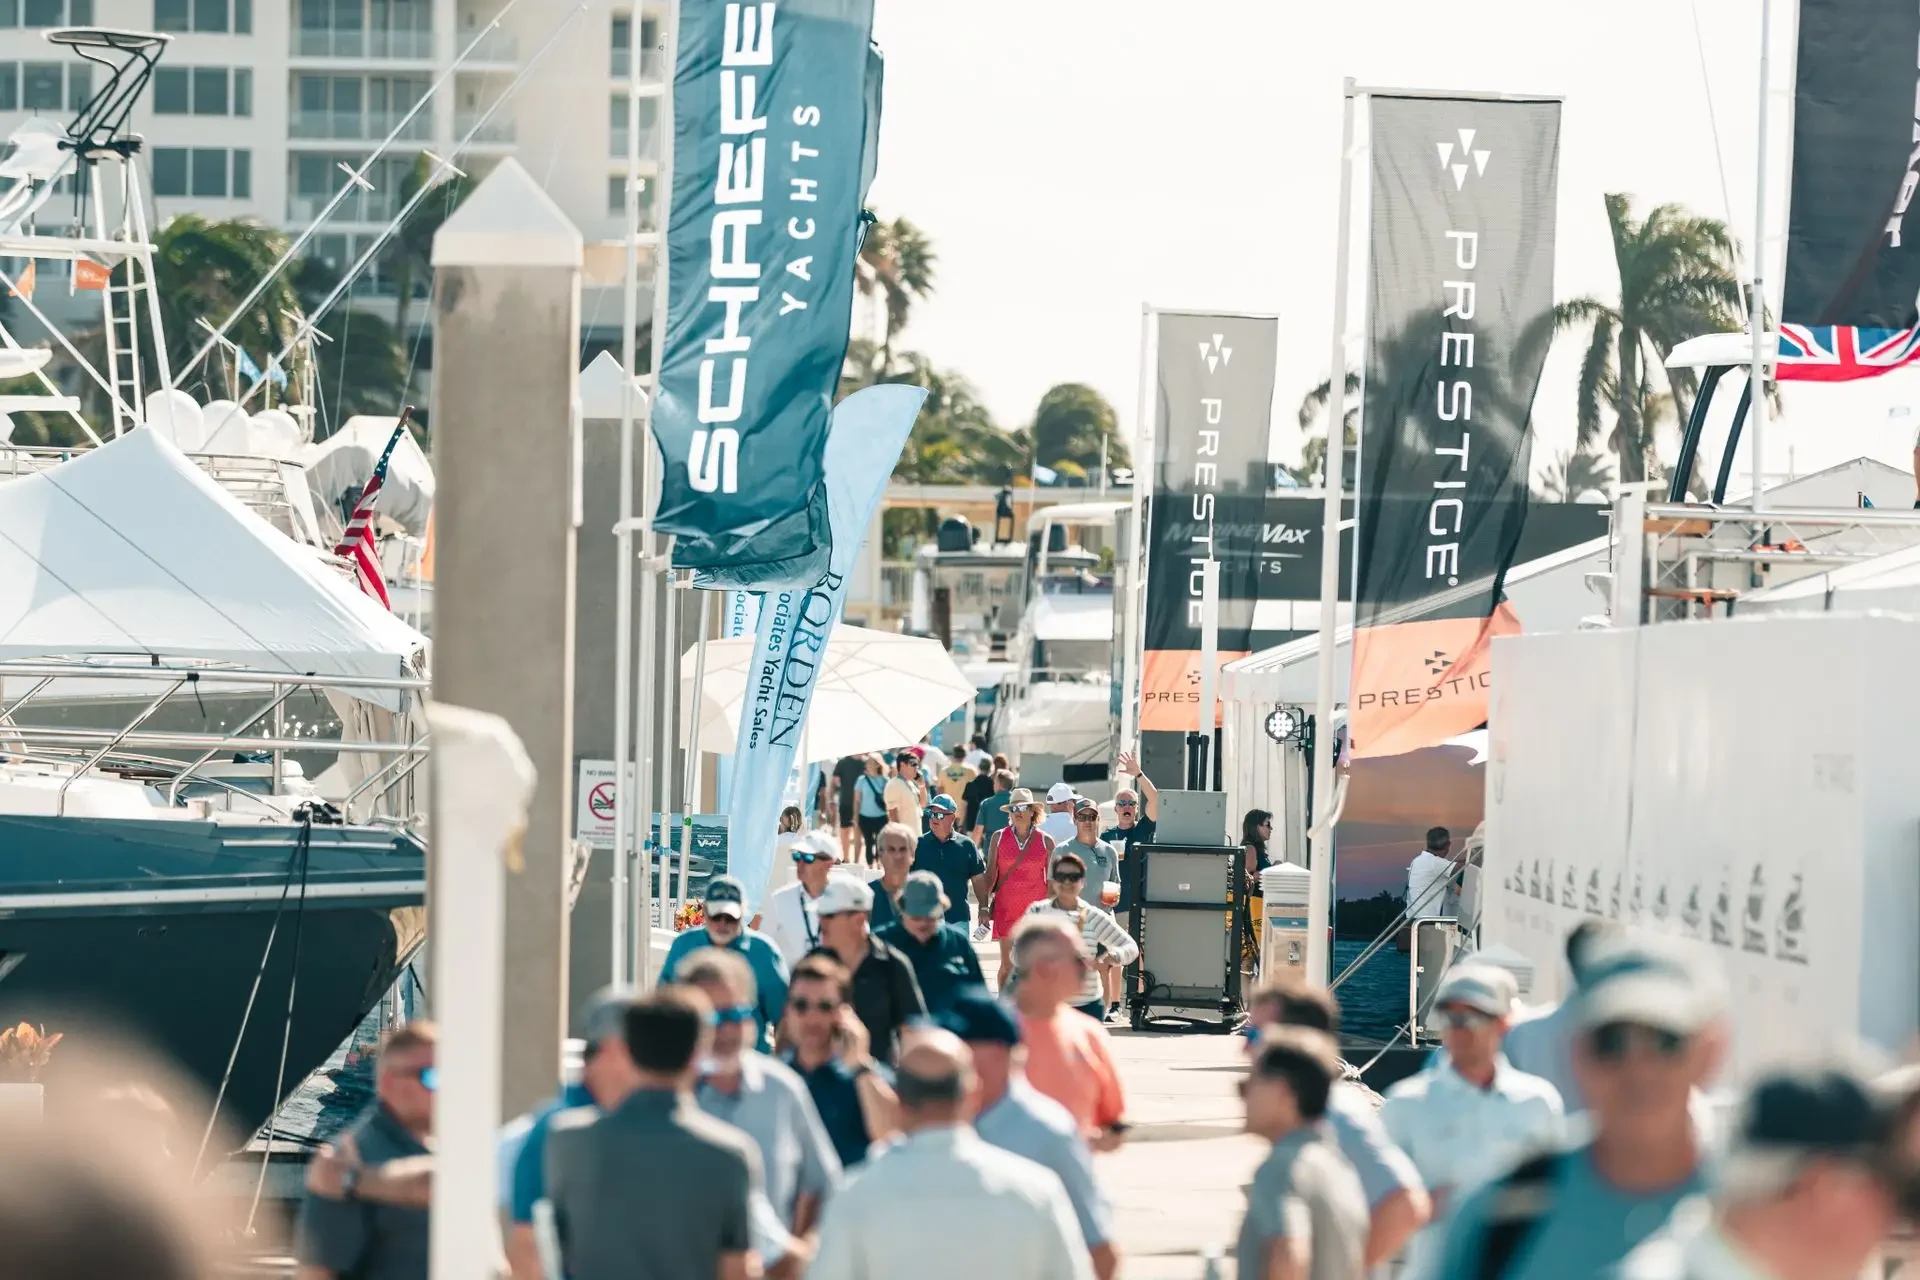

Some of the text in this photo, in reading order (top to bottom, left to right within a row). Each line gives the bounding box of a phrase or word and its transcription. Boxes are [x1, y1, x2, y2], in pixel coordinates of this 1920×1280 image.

[779, 104, 821, 316] YACHTS
[1425, 229, 1479, 580] PRESTIGE
[750, 590, 793, 750] ociates Yacht Sales
[769, 570, 843, 749] BORDEN
